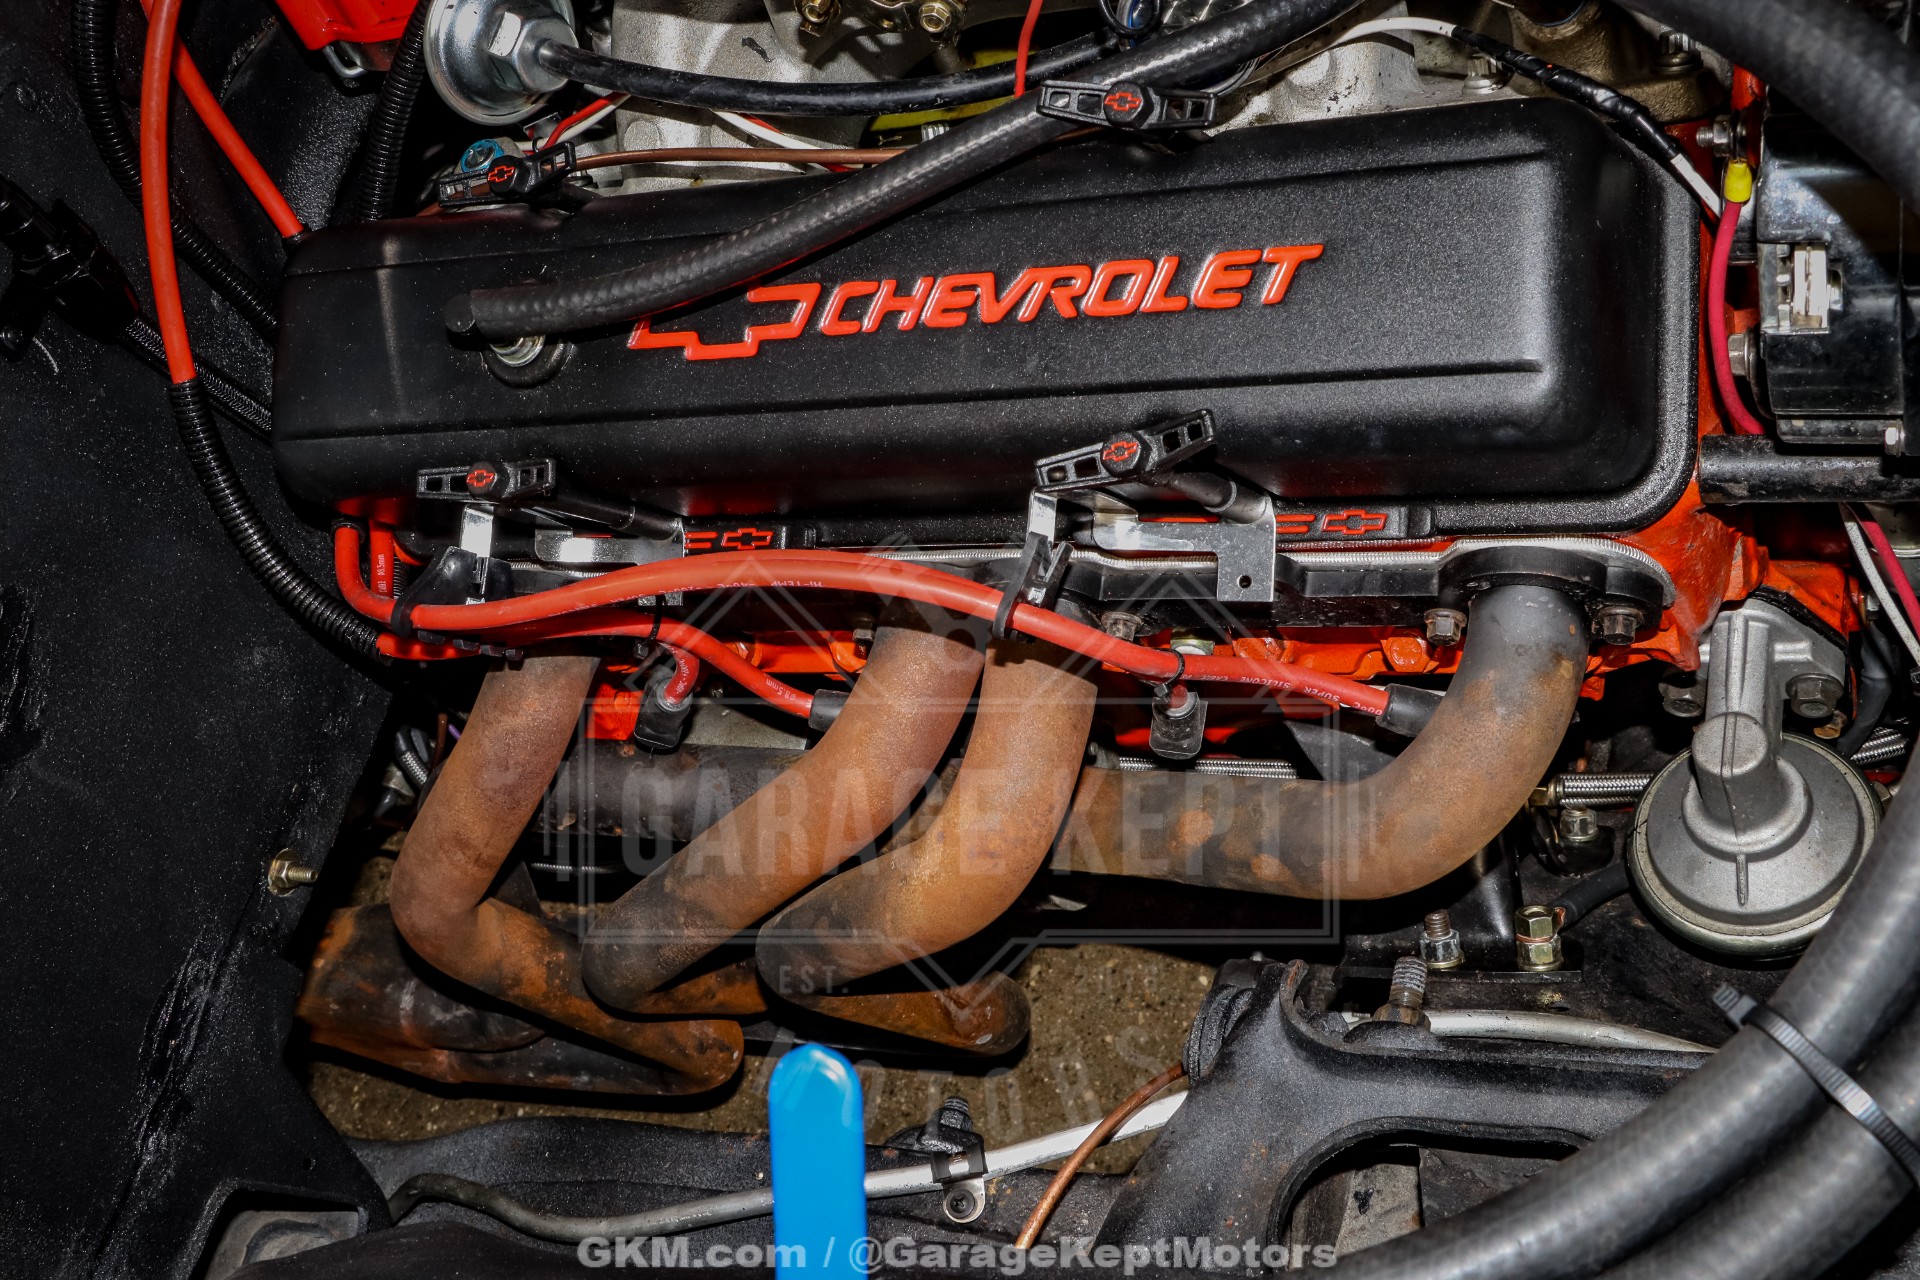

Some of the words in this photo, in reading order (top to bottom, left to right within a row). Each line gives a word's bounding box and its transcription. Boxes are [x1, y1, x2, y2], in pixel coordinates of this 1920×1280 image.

[818, 243, 1324, 337] CHEVROLET
[1239, 676, 1291, 689] SILICONE
[1303, 686, 1341, 702] SUPER
